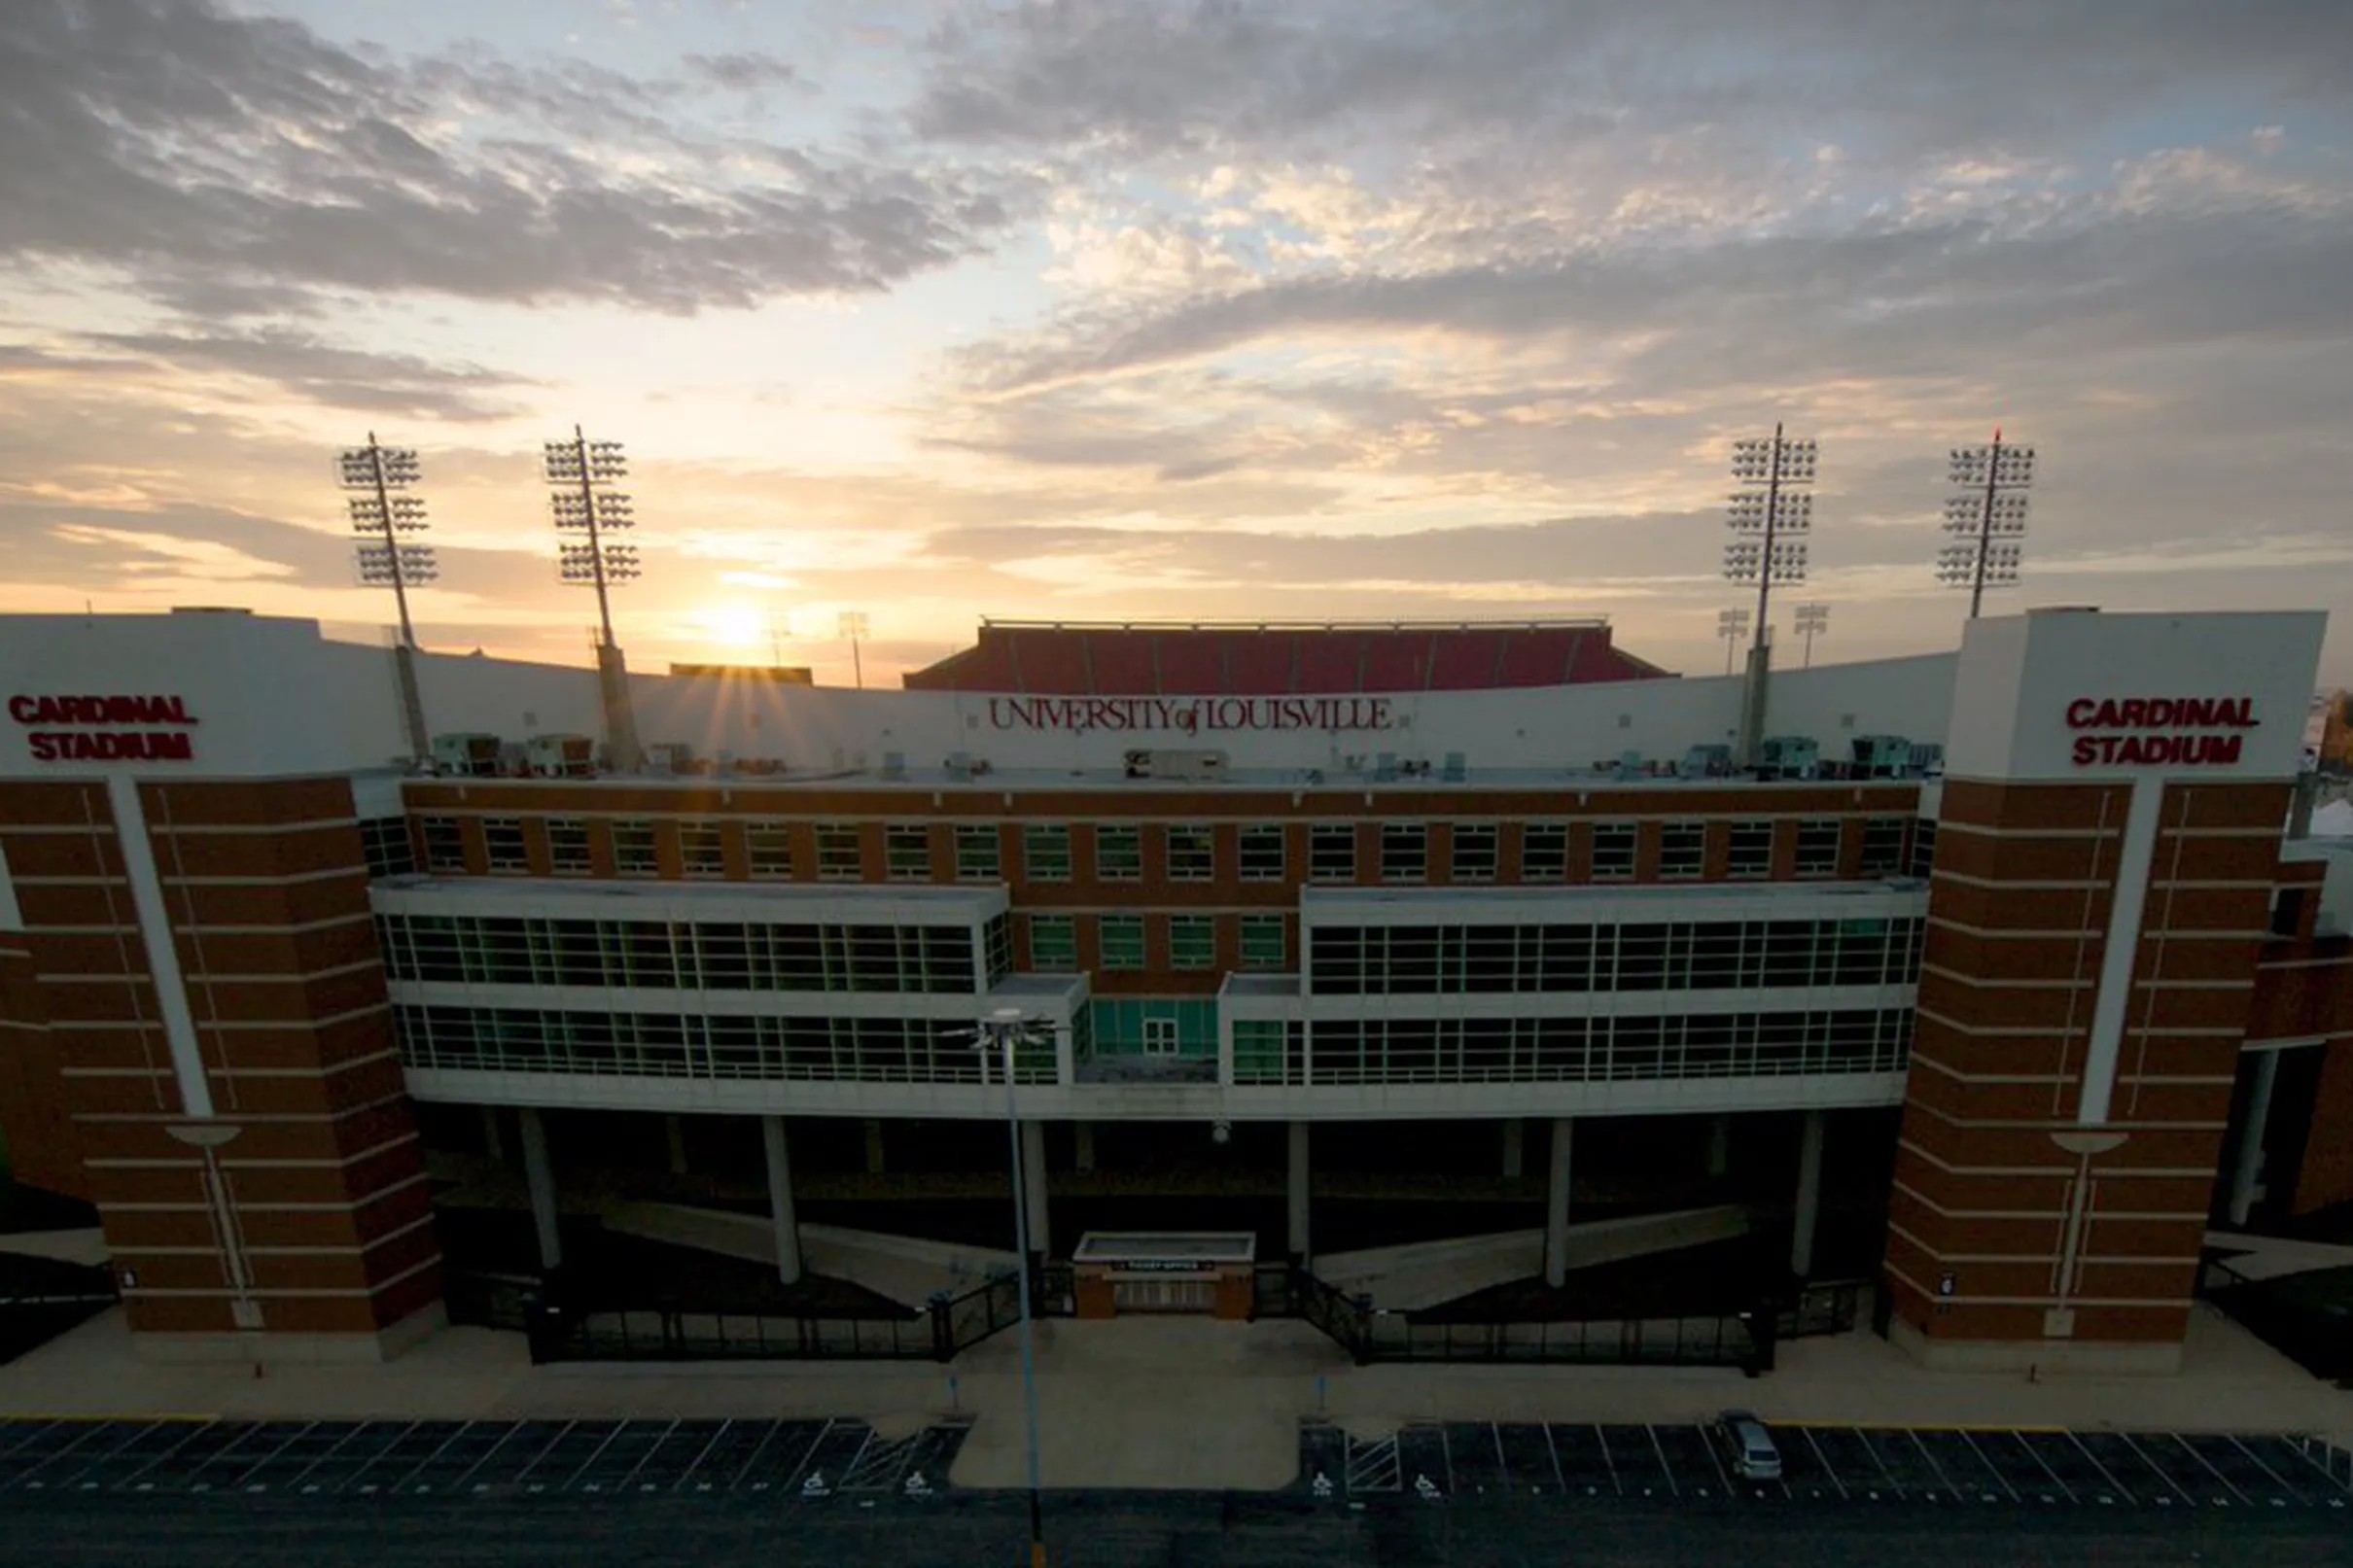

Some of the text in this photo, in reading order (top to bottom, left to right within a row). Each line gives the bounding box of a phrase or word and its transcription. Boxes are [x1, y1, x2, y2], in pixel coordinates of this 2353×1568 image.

[9, 695, 198, 724] CARDINAL
[989, 697, 1392, 737] UNIVERSITY of LOUISVILLE
[2067, 697, 2261, 727] CARDINAL
[28, 732, 193, 760] STADIUM
[2072, 735, 2242, 765] STADIUM
